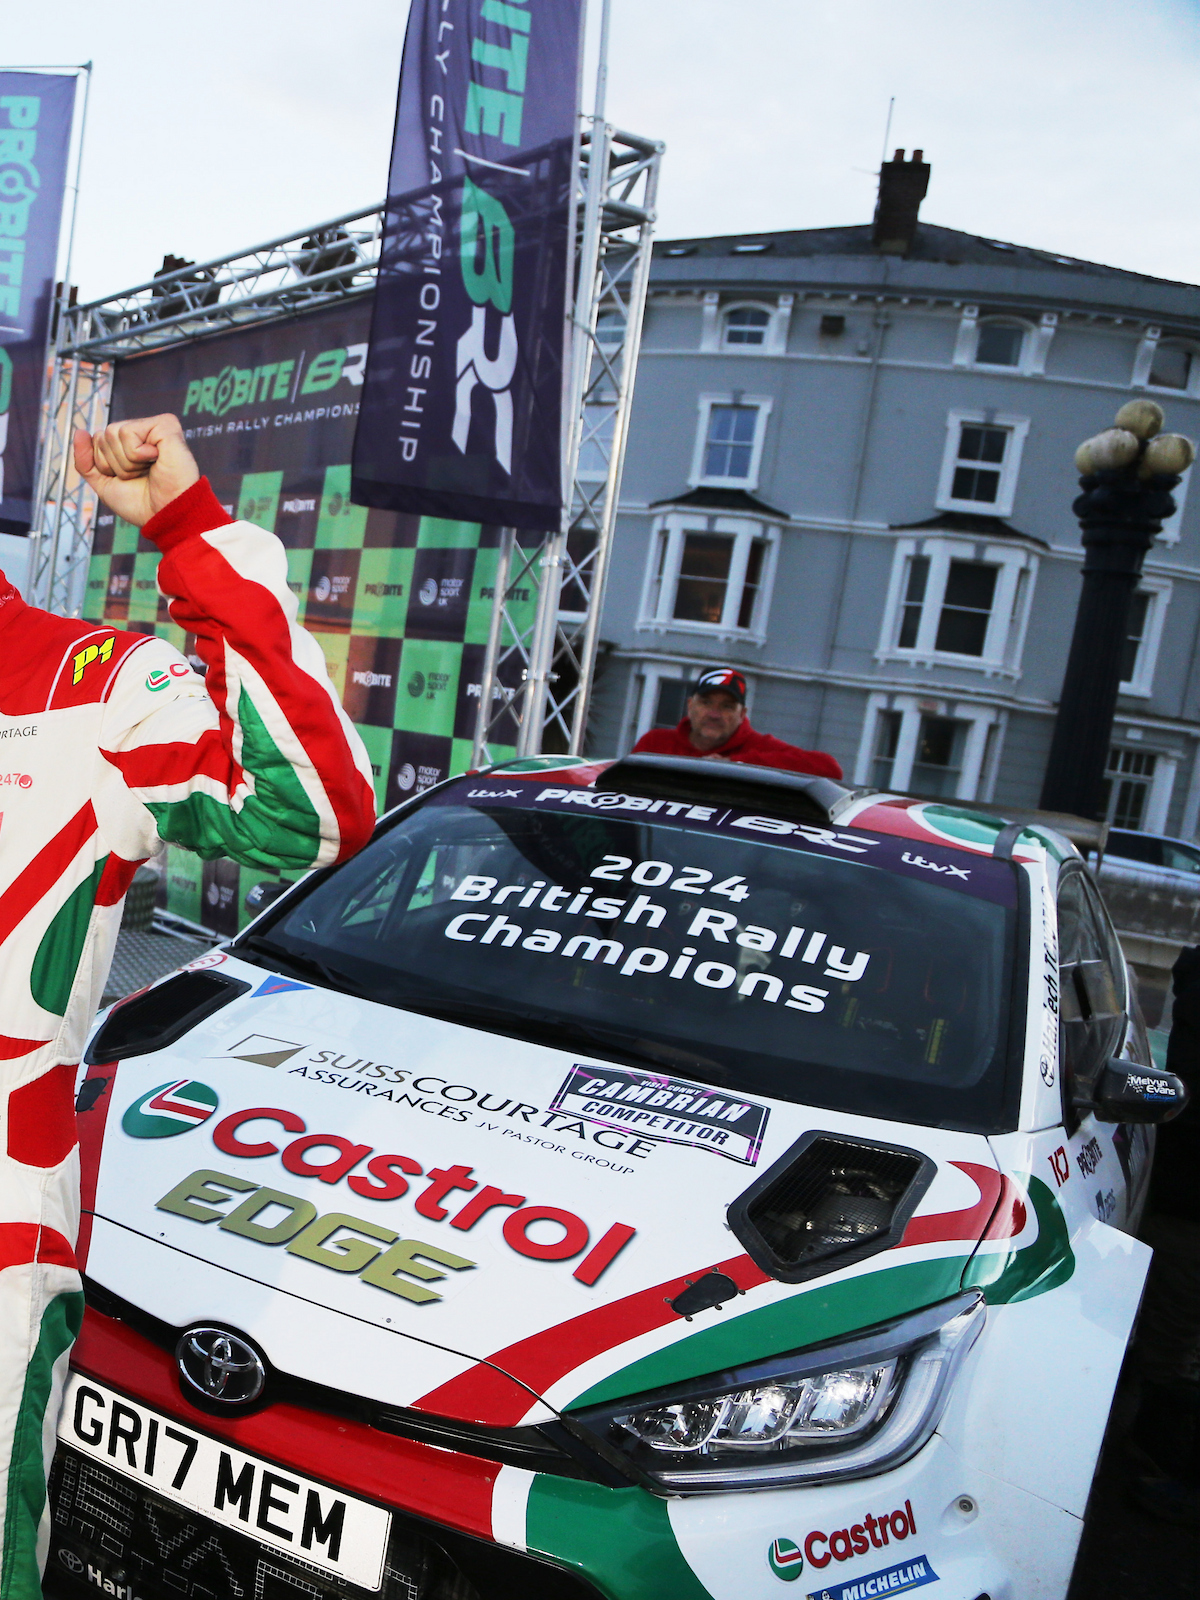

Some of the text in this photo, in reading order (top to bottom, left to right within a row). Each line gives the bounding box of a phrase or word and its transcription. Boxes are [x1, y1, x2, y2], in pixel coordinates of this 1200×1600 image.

[398, 94, 445, 463] CHAMPIONSHIP
[182, 358, 296, 417] PROBITE
[226, 416, 271, 432] RALLY
[480, 587, 530, 602] PRBITE
[72, 636, 116, 686] P1
[353, 671, 392, 688] PROBITE
[466, 683, 516, 700] PRBITE
[534, 788, 716, 822] PROBITE
[590, 854, 750, 904] 2024
[450, 875, 871, 982] British Rally
[444, 912, 830, 1014] Champions
[577, 1078, 752, 1123] CAMBRIAN
[1130, 1076, 1168, 1087] Melvyn
[1146, 1084, 1176, 1096] Evans
[288, 1066, 635, 1175] ASSURANCES JV PASTOR GROUP
[581, 1101, 731, 1146] COMPETITOR
[213, 1107, 637, 1286] Castrol
[154, 1169, 478, 1304] EDGE
[73, 1385, 199, 1491] GR17
[213, 1450, 347, 1562] MEM
[804, 1499, 918, 1569] Castrol
[839, 1562, 928, 1600] MICHELIN
